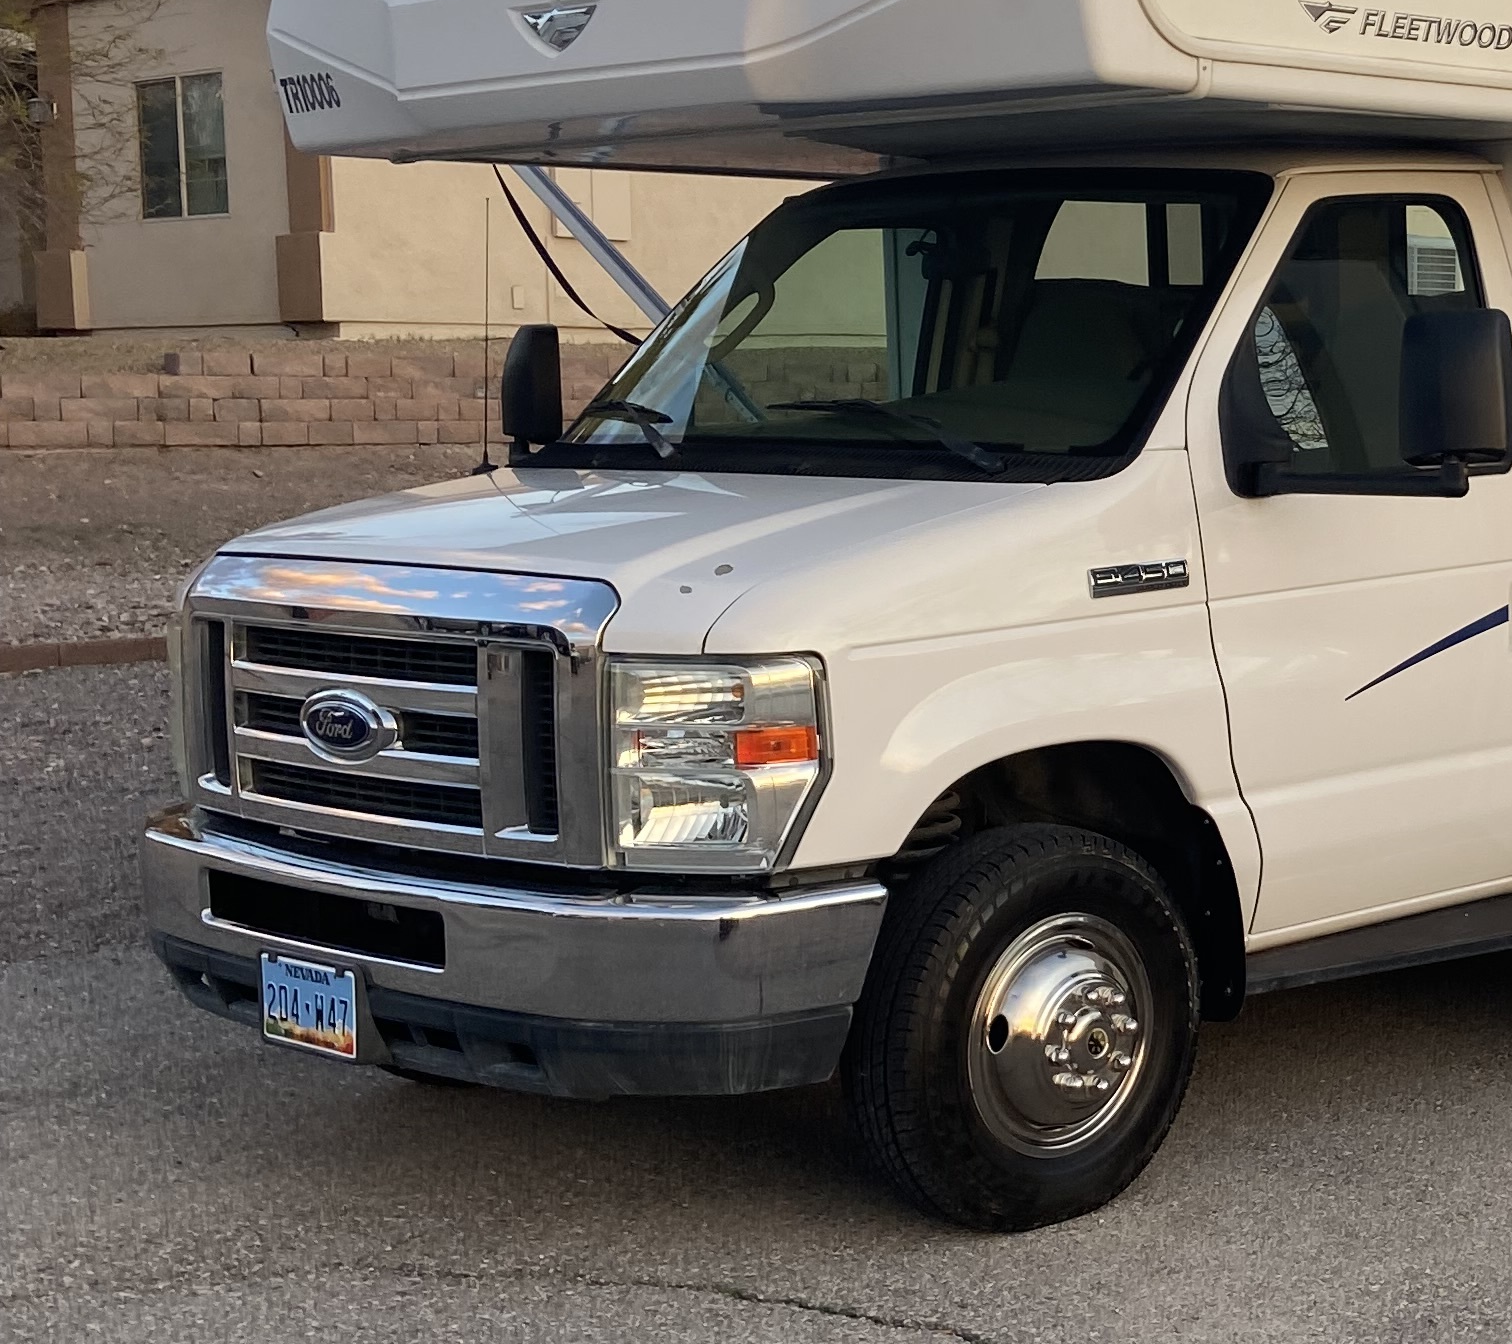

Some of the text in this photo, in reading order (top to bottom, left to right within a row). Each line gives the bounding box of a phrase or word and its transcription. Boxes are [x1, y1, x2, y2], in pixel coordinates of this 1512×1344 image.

[279, 72, 341, 114] TR10006
[315, 708, 354, 739] Ford
[284, 963, 331, 986] NEVADA
